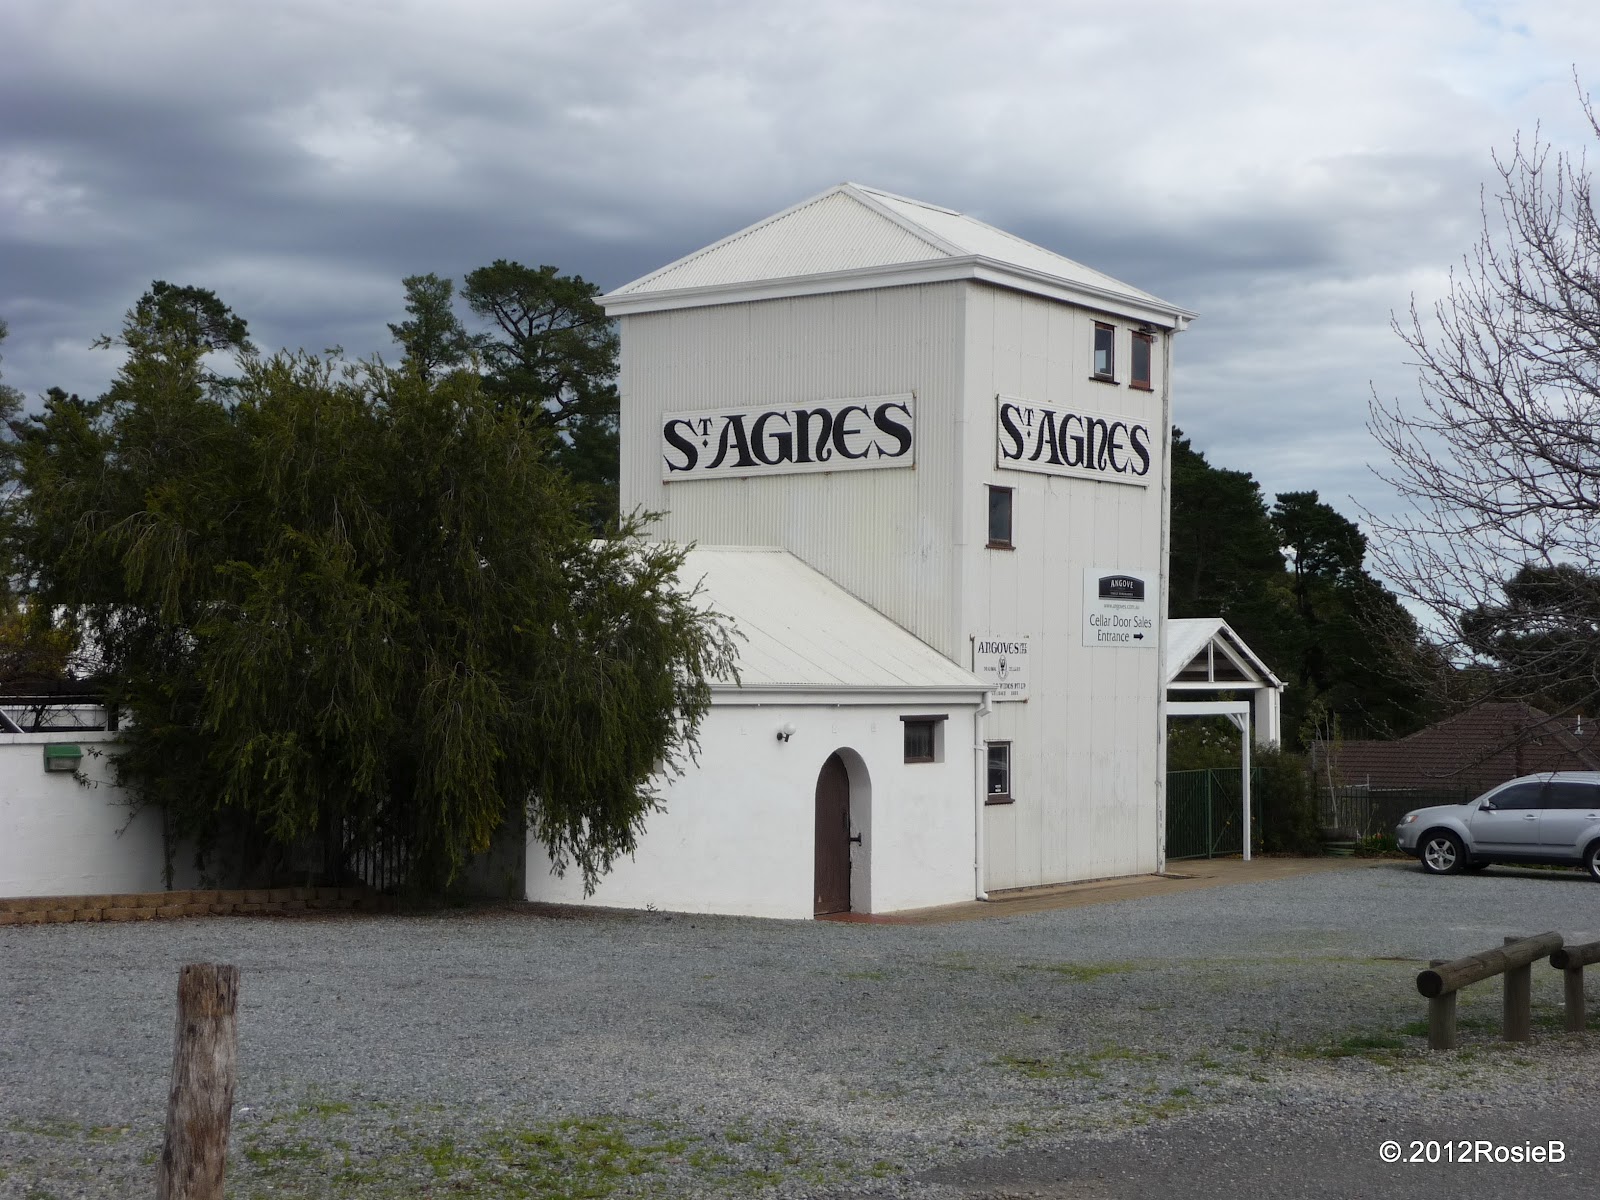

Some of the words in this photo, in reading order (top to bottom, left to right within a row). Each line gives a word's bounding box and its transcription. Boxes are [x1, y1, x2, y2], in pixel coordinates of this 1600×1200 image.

[705, 402, 913, 469] AGNES
[1030, 408, 1151, 476] AGNES
[1110, 579, 1134, 589] ANGOVE
[1089, 613, 1111, 627] Cellar
[1113, 615, 1131, 628] Door
[1133, 615, 1152, 629] Sales
[1097, 629, 1130, 642] Entrance
[977, 641, 1019, 654] ANGOVES
